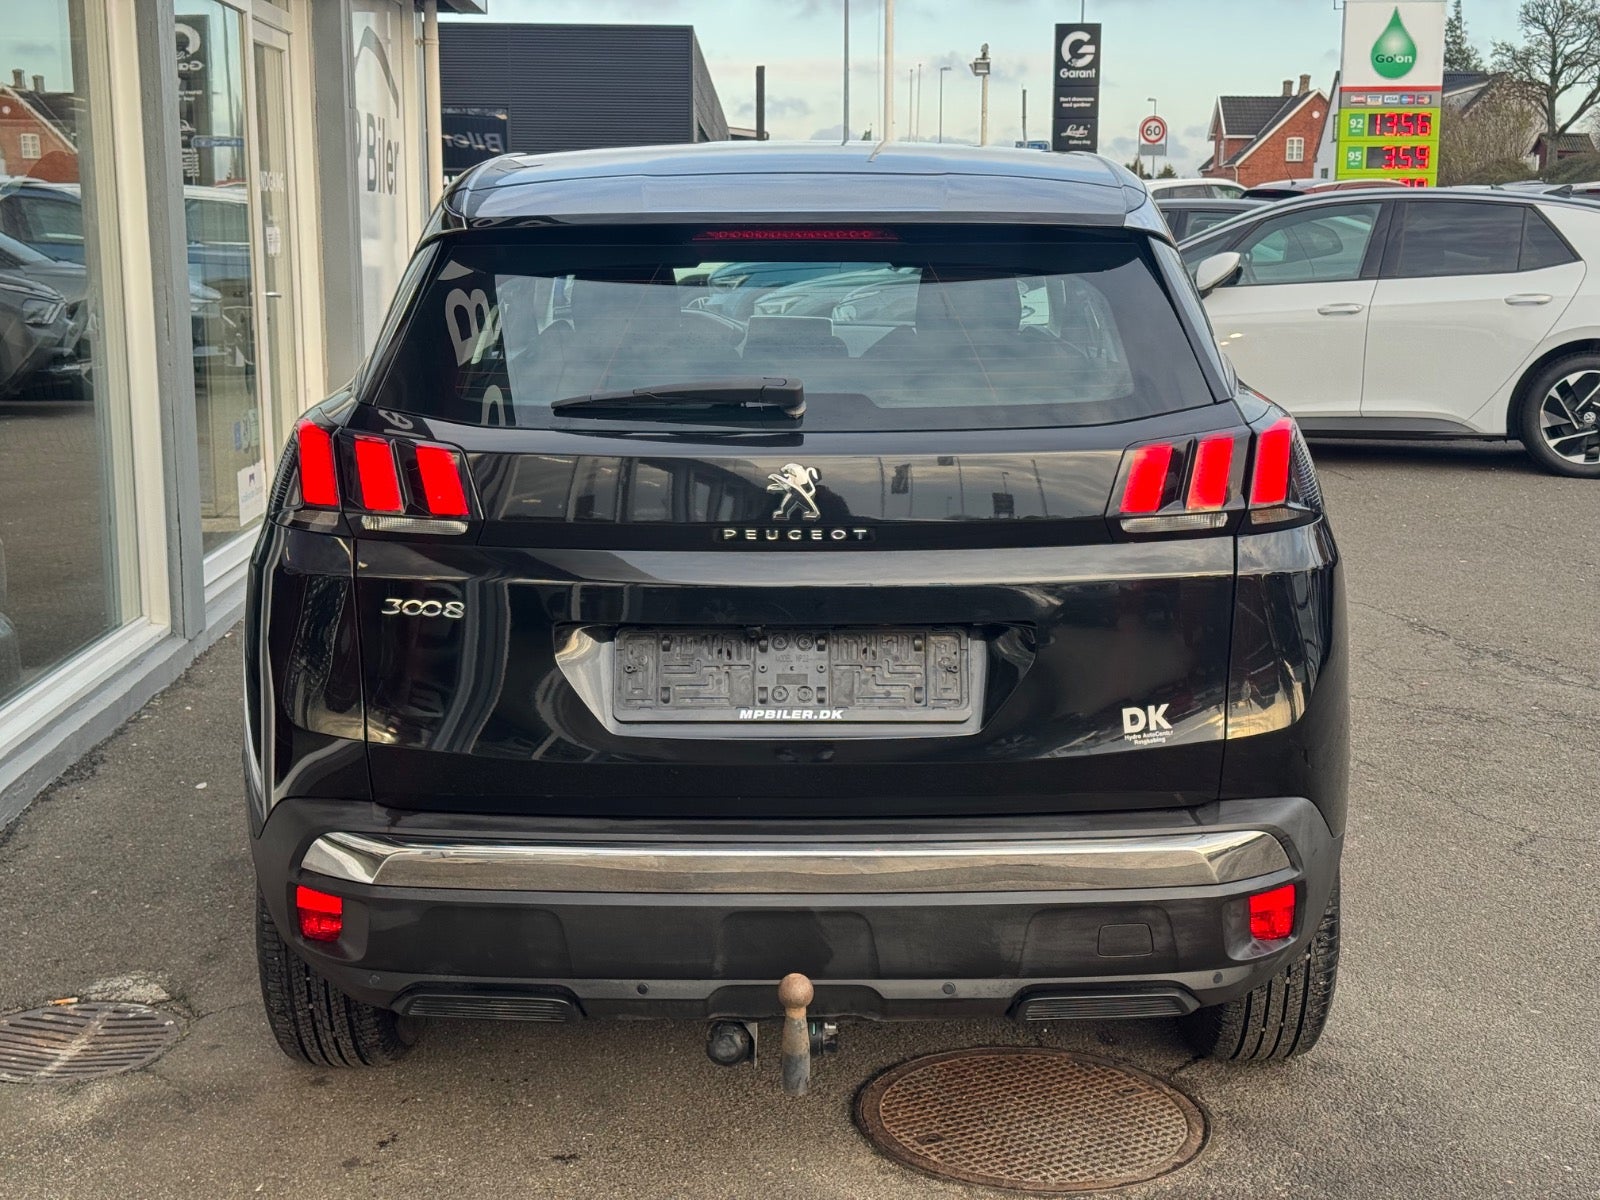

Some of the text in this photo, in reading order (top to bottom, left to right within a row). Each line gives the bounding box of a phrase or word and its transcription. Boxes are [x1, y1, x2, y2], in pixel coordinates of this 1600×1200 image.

[1059, 68, 1096, 78] Garant
[1349, 118, 1364, 129] 92
[1145, 125, 1161, 137] 60
[366, 112, 400, 196] Biler
[1348, 151, 1362, 161] 95
[723, 529, 867, 541] PEUGEOT
[381, 598, 465, 619] 3008
[739, 709, 844, 720] MPBILER.DK
[1122, 703, 1173, 734] DK
